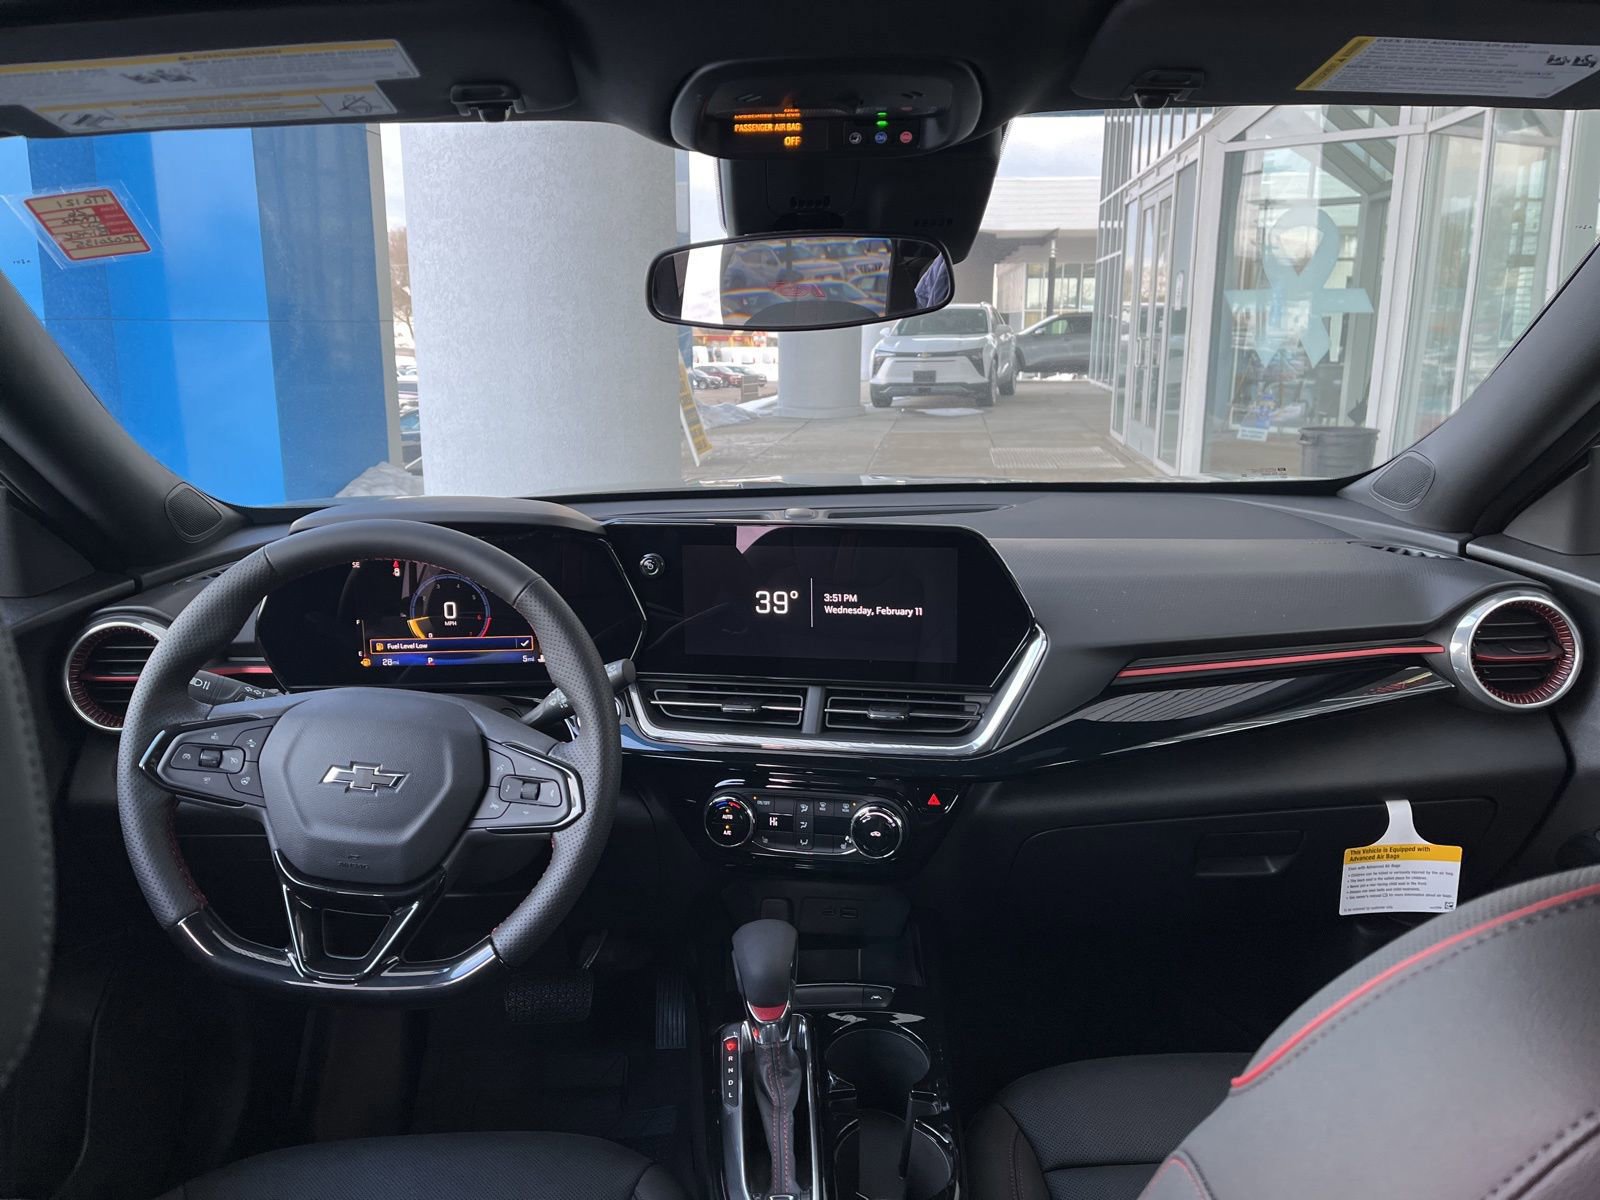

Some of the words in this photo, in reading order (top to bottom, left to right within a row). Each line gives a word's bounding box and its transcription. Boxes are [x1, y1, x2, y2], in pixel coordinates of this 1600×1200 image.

[734, 124, 772, 132] PASSENGER
[784, 136, 802, 146] OFF
[755, 590, 798, 614] 39°
[824, 593, 842, 602] 3:51
[844, 593, 858, 602] PM
[443, 601, 457, 620] 0
[824, 605, 874, 616] Wednesday,
[876, 606, 913, 618] February
[914, 607, 923, 616] 11
[769, 816, 778, 827] Hi
